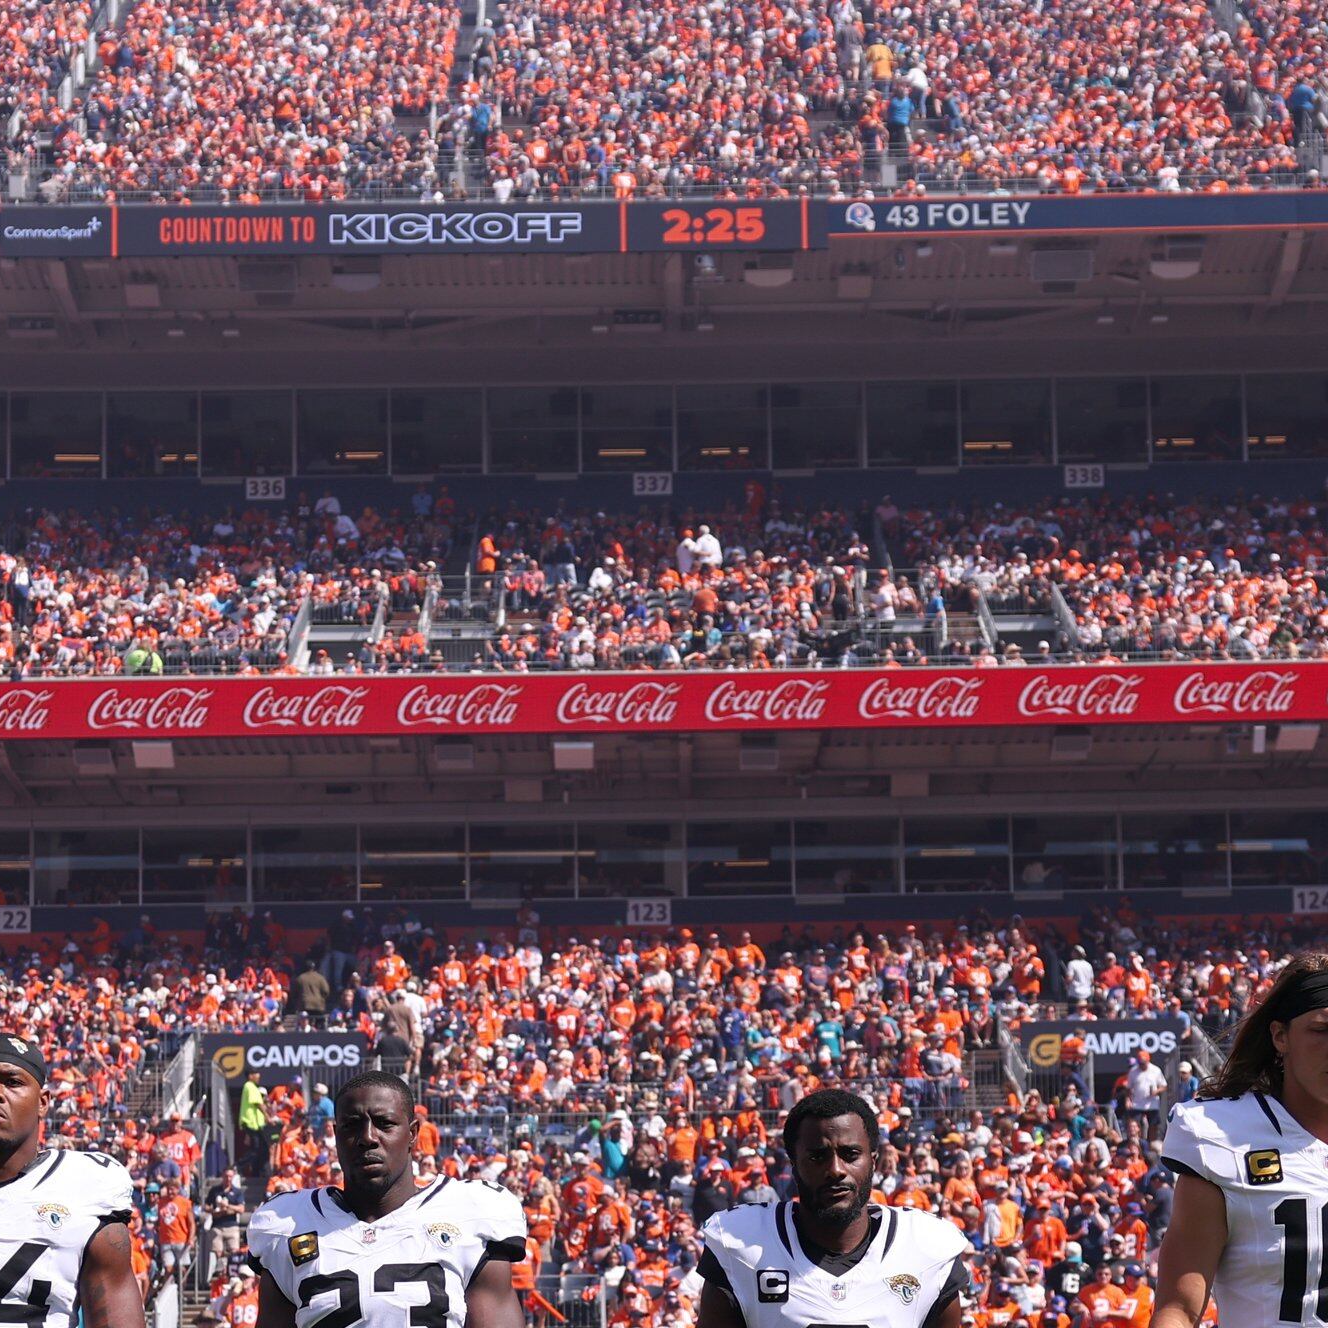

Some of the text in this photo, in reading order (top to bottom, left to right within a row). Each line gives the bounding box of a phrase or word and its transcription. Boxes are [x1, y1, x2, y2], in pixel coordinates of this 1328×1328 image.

[662, 207, 766, 243] 2:25
[886, 201, 1031, 228] 43 FOLEY
[160, 212, 582, 245] COUNTDOWN TO KICKOFF
[636, 475, 669, 492] 337
[1067, 467, 1101, 484] 338
[249, 479, 282, 496] 336
[631, 902, 667, 921] 123
[246, 1044, 361, 1068] CAMPOS
[1248, 1150, 1281, 1177] C
[759, 1271, 787, 1294] C
